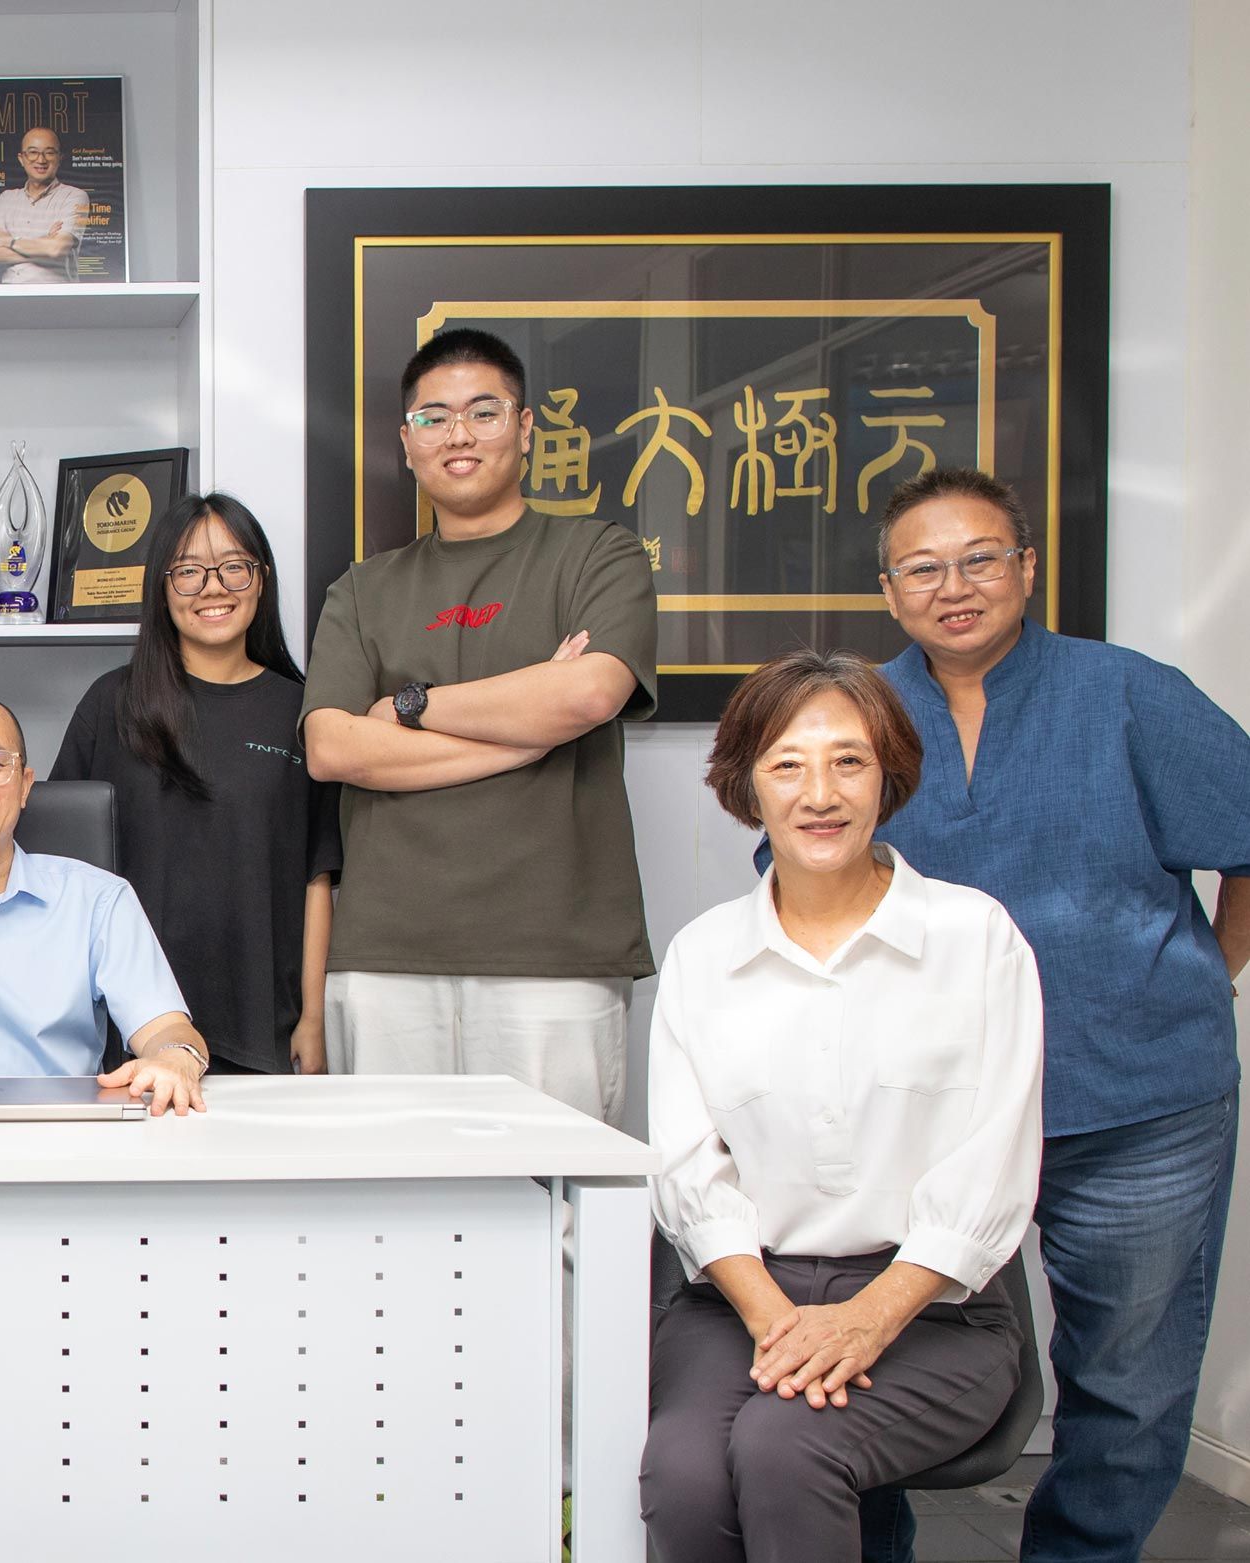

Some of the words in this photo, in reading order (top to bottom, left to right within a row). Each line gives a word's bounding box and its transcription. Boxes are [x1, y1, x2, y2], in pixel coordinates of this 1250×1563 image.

[91, 203, 112, 213] Time
[114, 519, 137, 527] MARINE
[425, 602, 503, 631] STONED
